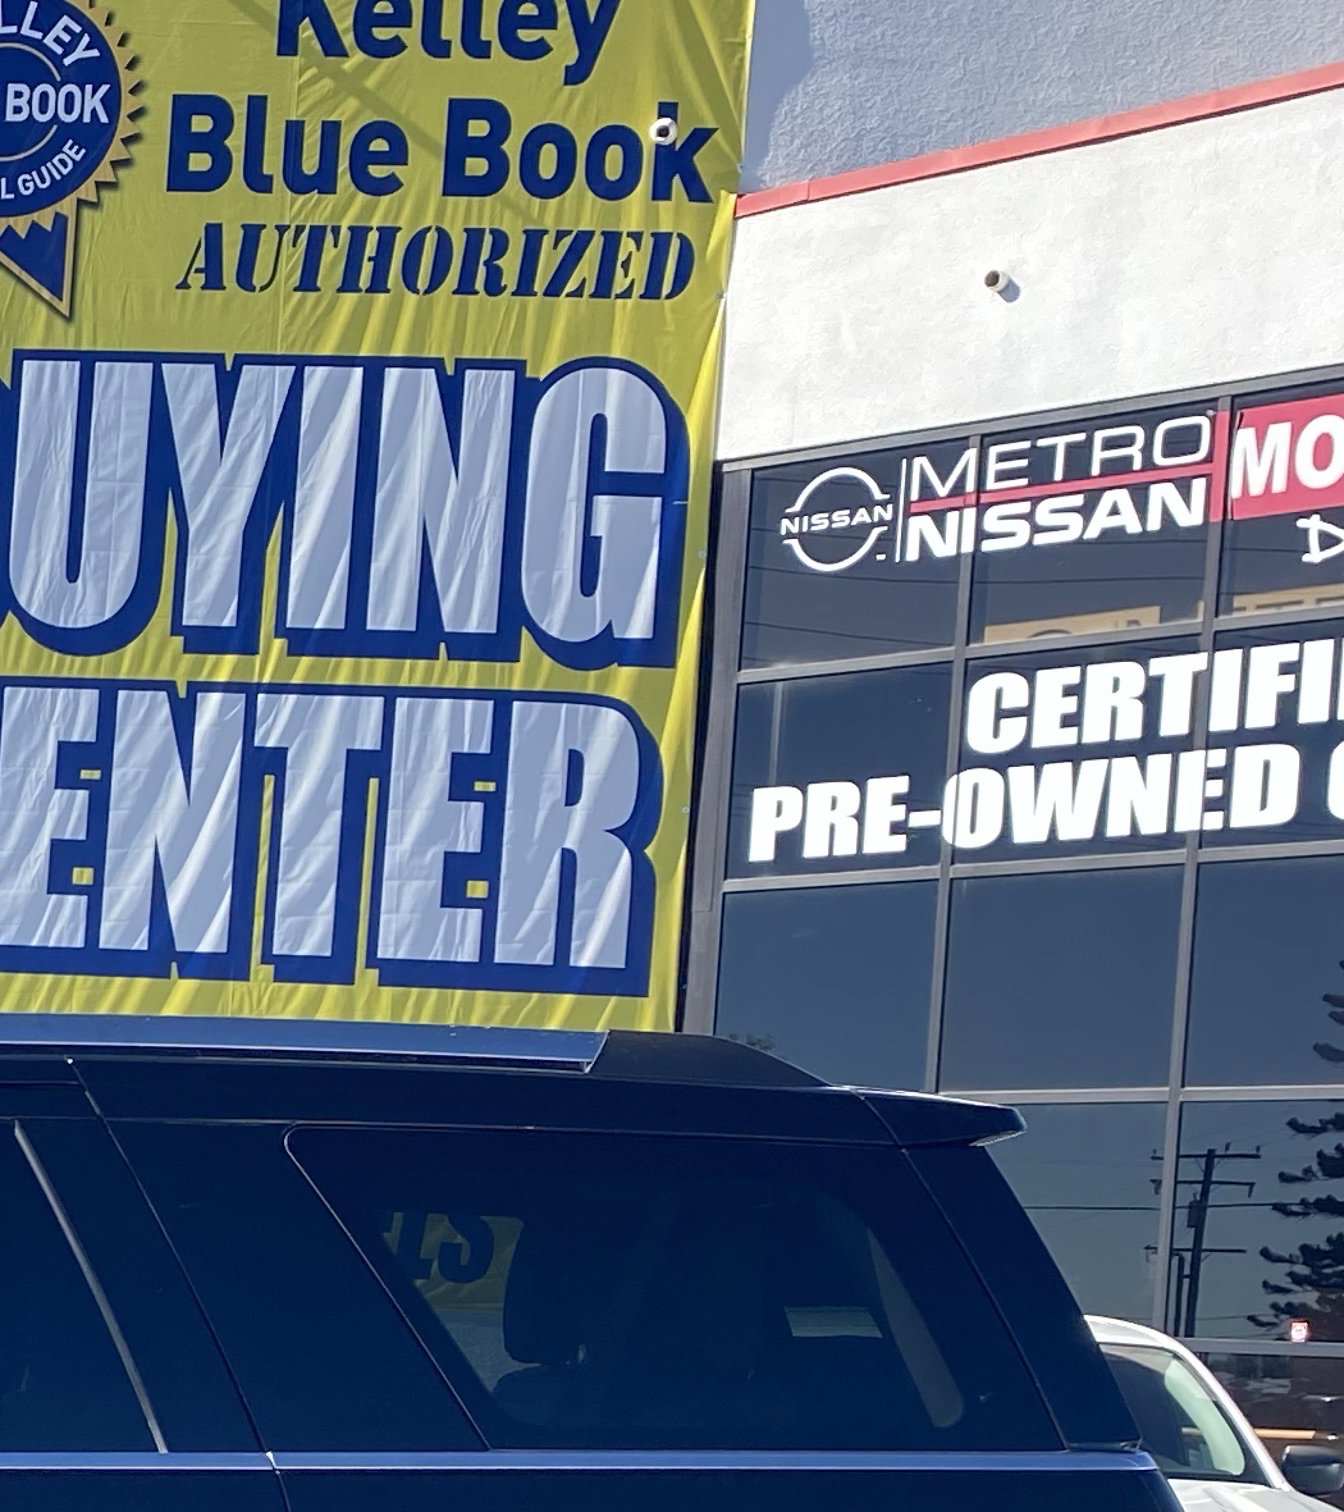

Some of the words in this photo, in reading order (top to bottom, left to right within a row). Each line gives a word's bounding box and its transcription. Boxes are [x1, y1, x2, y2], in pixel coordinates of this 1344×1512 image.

[275, 0, 624, 86] Kelley
[5, 83, 111, 123] BOOK
[17, 139, 86, 196] GUIDE
[166, 93, 409, 195] Blue
[442, 99, 719, 203] Book
[176, 221, 694, 301] AUTHORIZED
[909, 413, 1211, 500] METRO
[780, 502, 894, 536] NISSAN
[907, 477, 1207, 561] NISSAN
[966, 636, 1344, 753] CERTIFI
[748, 742, 1301, 863] PRE-OWNED
